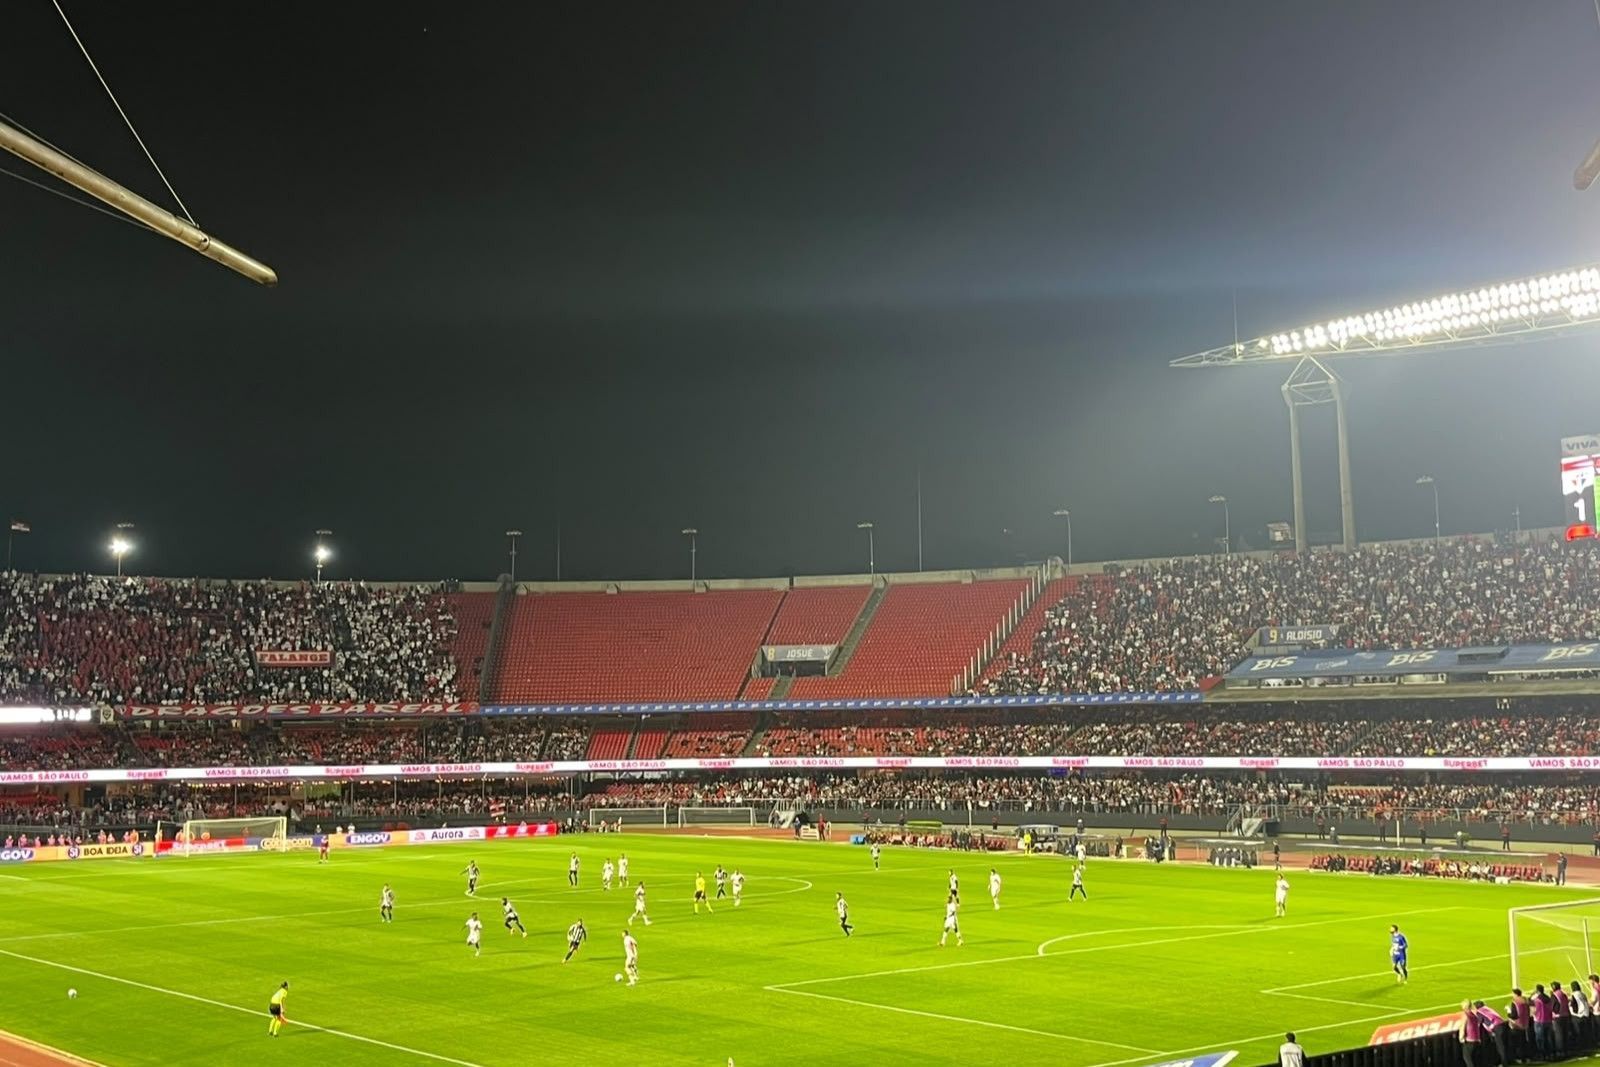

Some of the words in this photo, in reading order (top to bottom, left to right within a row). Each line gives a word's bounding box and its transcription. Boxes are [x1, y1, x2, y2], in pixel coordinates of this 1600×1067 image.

[1566, 440, 1599, 450] VIVA
[1574, 498, 1586, 521] 1
[1269, 629, 1278, 643] 9
[259, 653, 329, 663] FALANGE
[768, 647, 775, 660] 8
[639, 760, 666, 768] PAULO
[769, 759, 797, 767] VAMOS
[818, 758, 845, 766] PAULO
[944, 758, 973, 766] VAMOS
[993, 758, 1020, 766] PAULO
[1123, 759, 1154, 767] VAMOS
[1175, 759, 1204, 767] PAULO
[1316, 759, 1349, 768] VAMOS
[1373, 759, 1405, 768] PAULO
[1528, 759, 1566, 768] VAMOS
[205, 769, 237, 777] VAMOS
[260, 767, 289, 776] PAULO
[454, 764, 482, 772] PAULO
[0, 772, 34, 782] VAMOS
[58, 771, 89, 781] PAULO
[350, 834, 390, 844] ENGOV
[431, 831, 464, 840] Aurora
[83, 848, 103, 856] BOA
[106, 846, 128, 855] IDEIA
